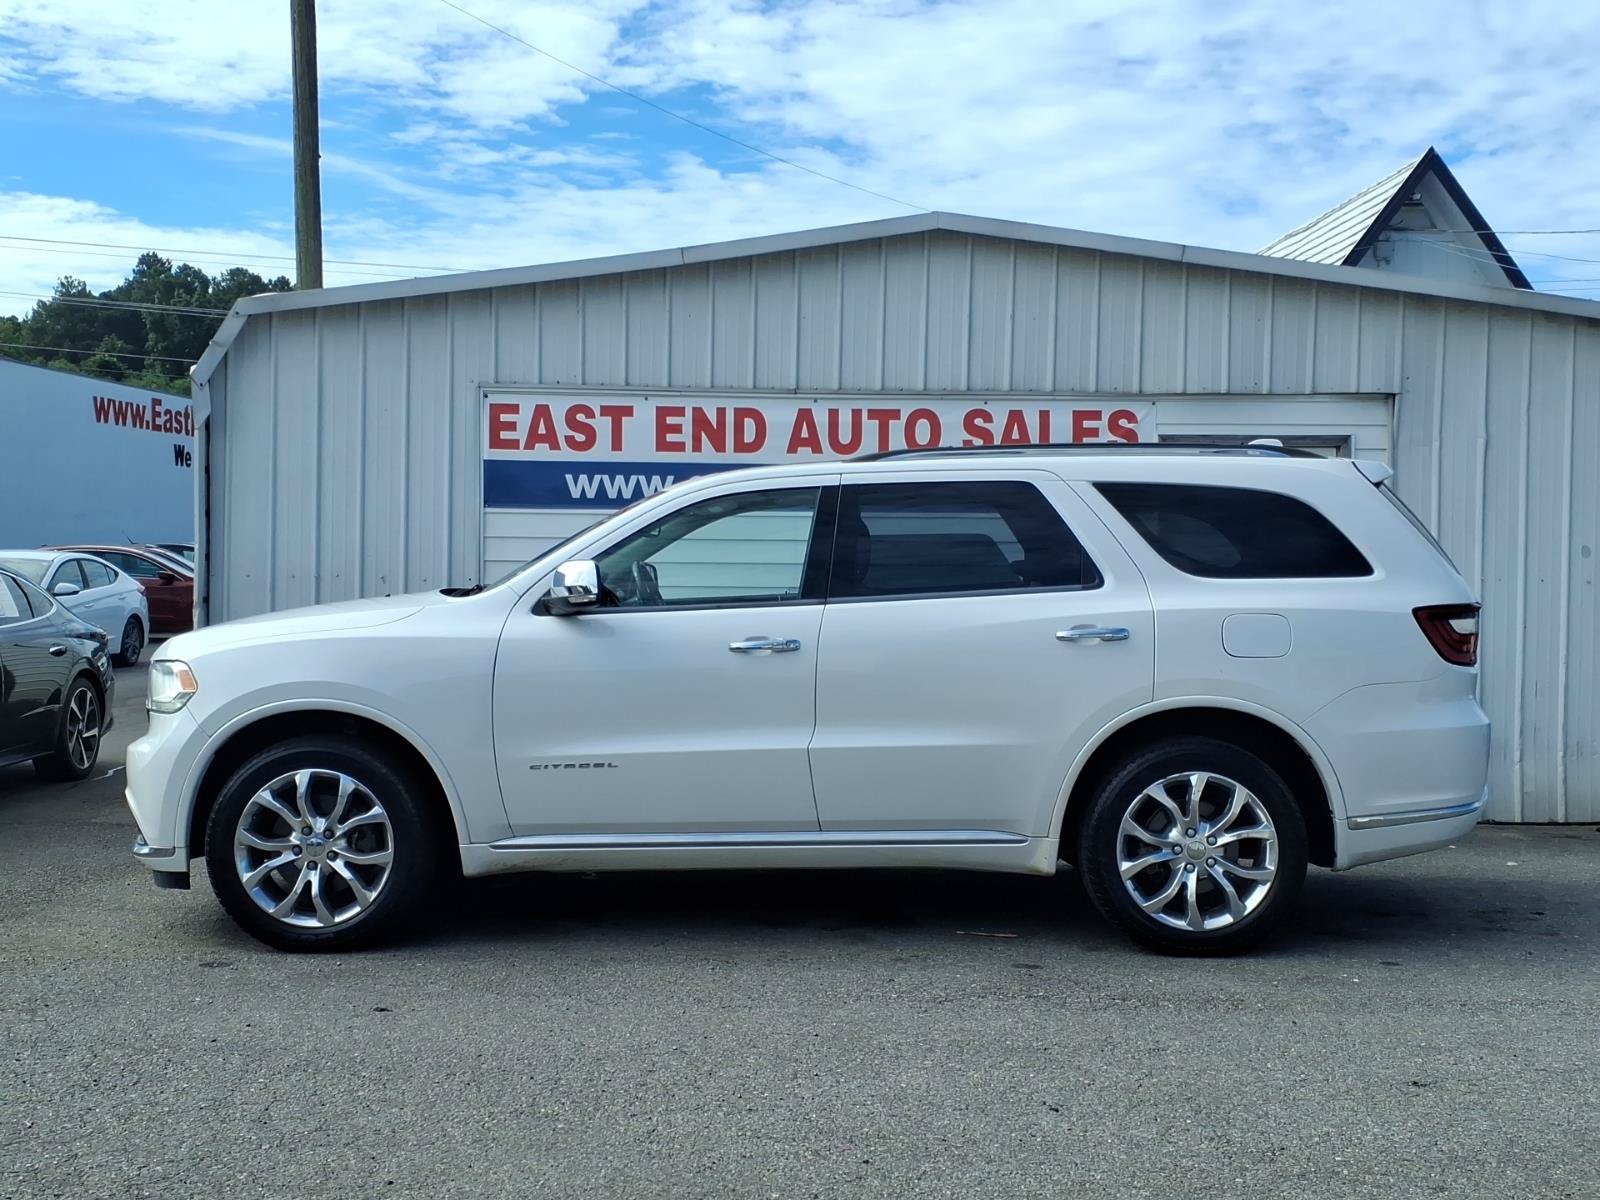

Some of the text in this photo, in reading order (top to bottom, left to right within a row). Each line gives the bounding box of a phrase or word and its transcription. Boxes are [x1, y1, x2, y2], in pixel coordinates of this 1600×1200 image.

[488, 403, 634, 452] EAST
[655, 405, 767, 453] END
[786, 407, 942, 455] AUTO
[173, 443, 192, 468] We
[528, 762, 619, 770] CITADEL
